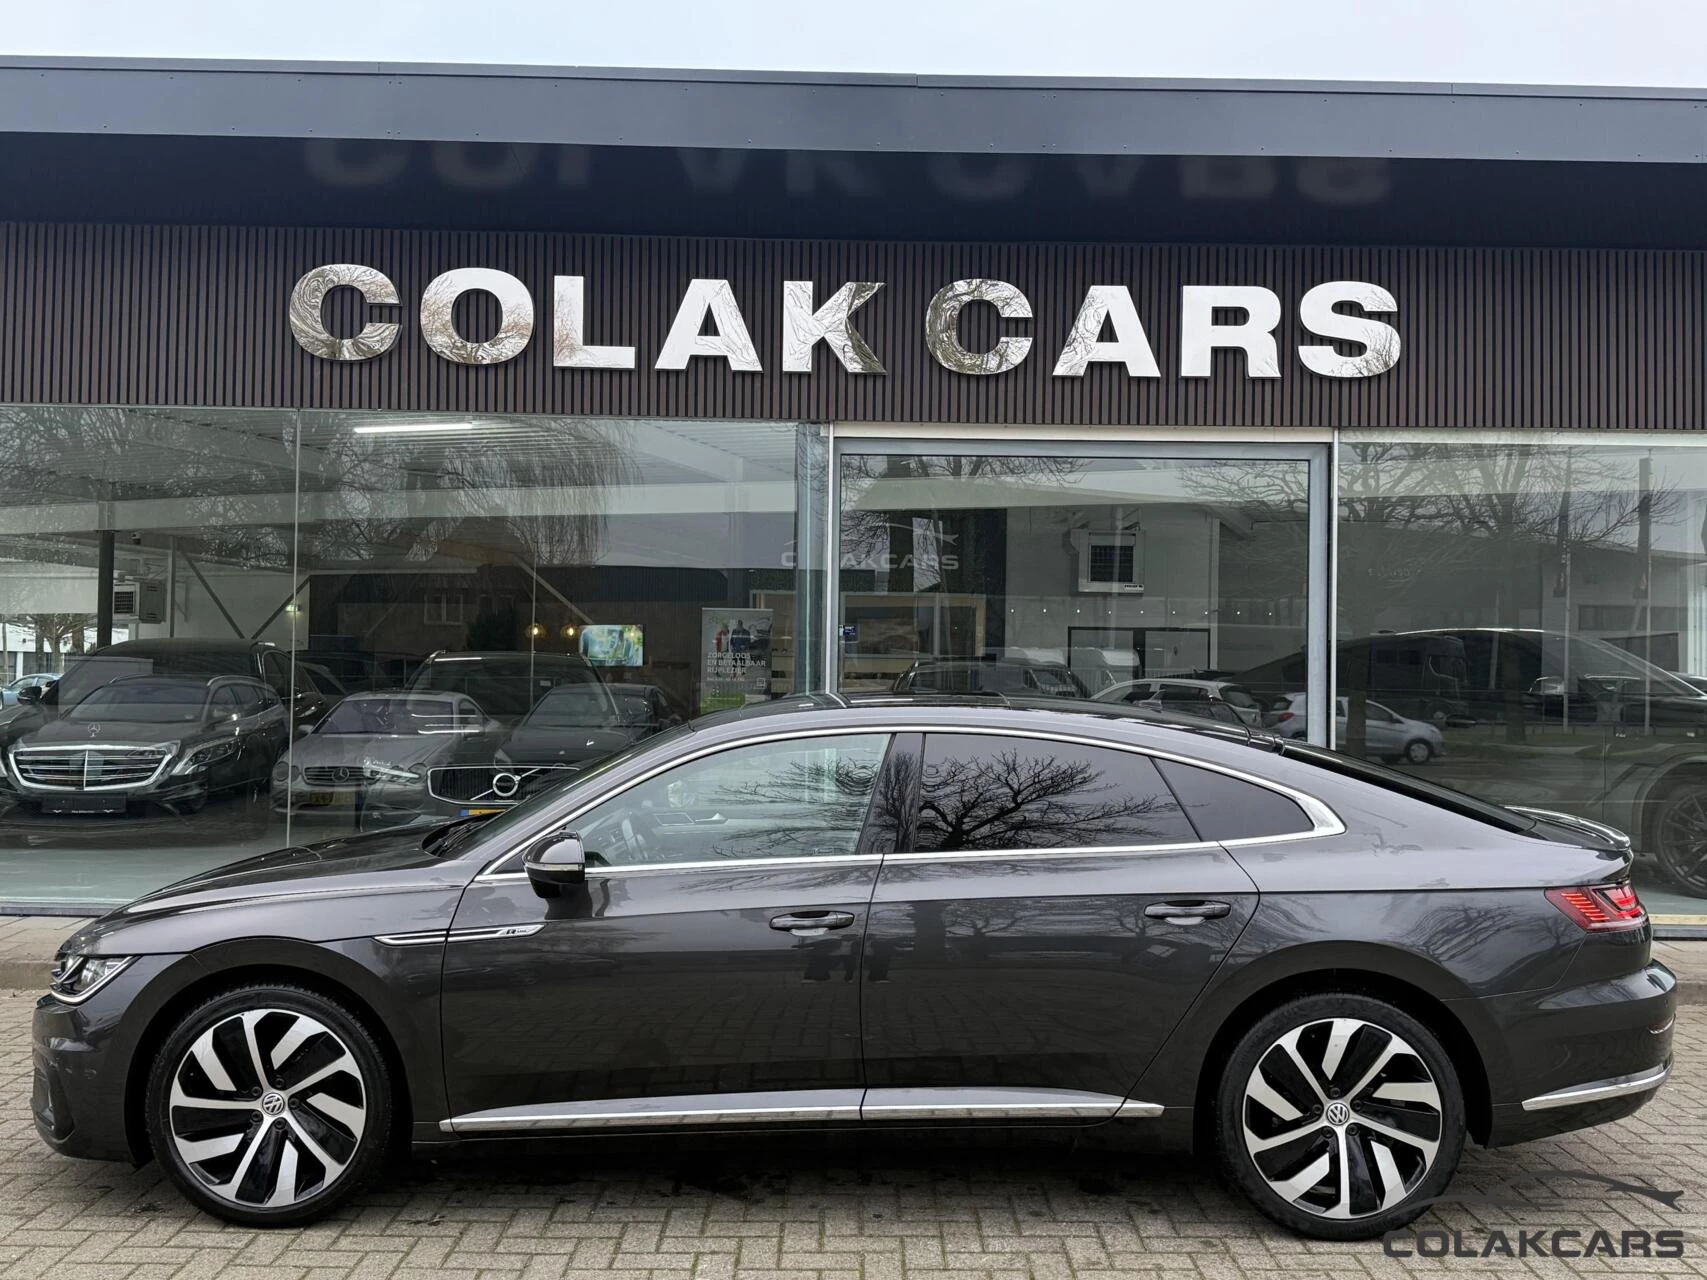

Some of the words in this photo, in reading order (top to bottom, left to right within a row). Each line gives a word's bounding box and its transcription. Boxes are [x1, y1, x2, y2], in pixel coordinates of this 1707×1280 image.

[288, 263, 885, 375] COLAK
[923, 276, 1402, 381] CARS
[780, 551, 960, 570] CAKCARS
